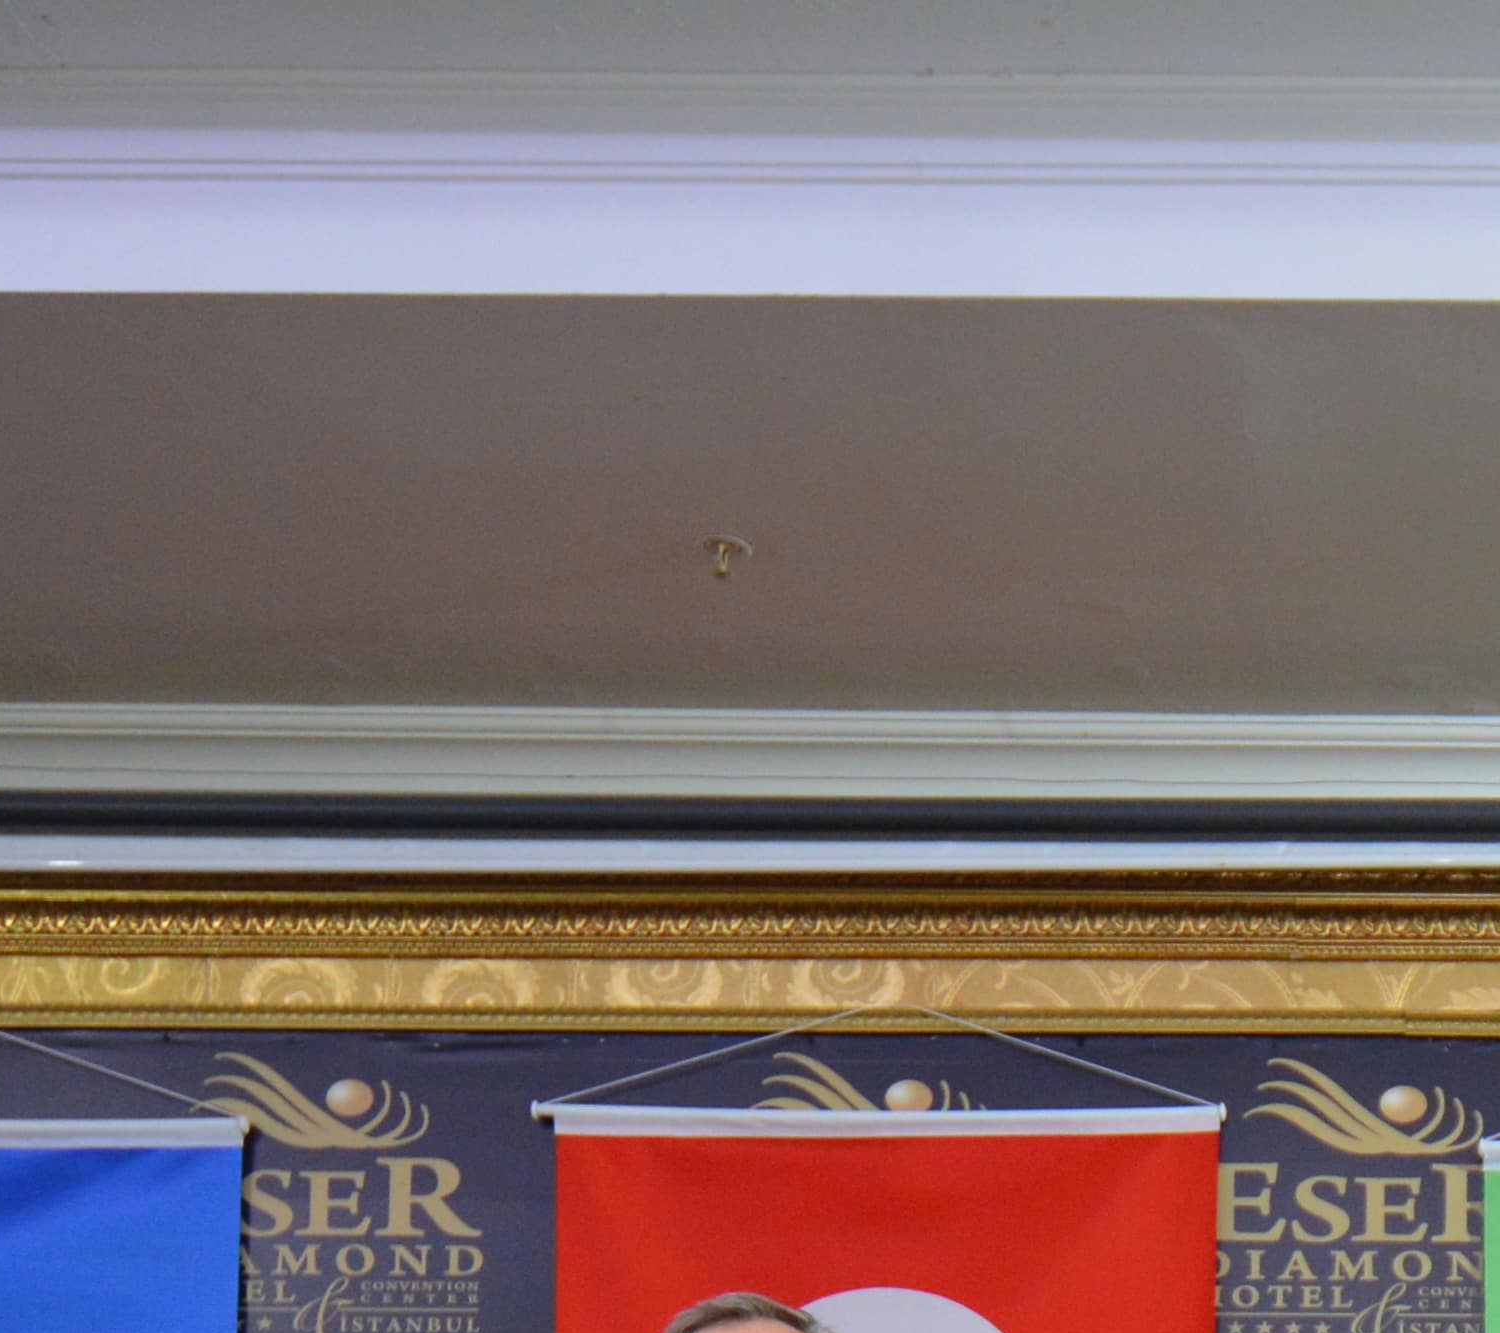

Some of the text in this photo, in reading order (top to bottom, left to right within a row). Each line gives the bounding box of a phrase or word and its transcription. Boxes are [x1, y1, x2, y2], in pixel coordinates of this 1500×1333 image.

[240, 1157, 483, 1237] SER
[239, 1244, 484, 1277] AMOND
[1216, 1250, 1483, 1282] IAMON
[360, 1281, 481, 1291] CONVENTION
[1215, 1285, 1354, 1309] OTEL
[360, 1294, 480, 1304] CENTER
[1418, 1299, 1474, 1309] CEN
